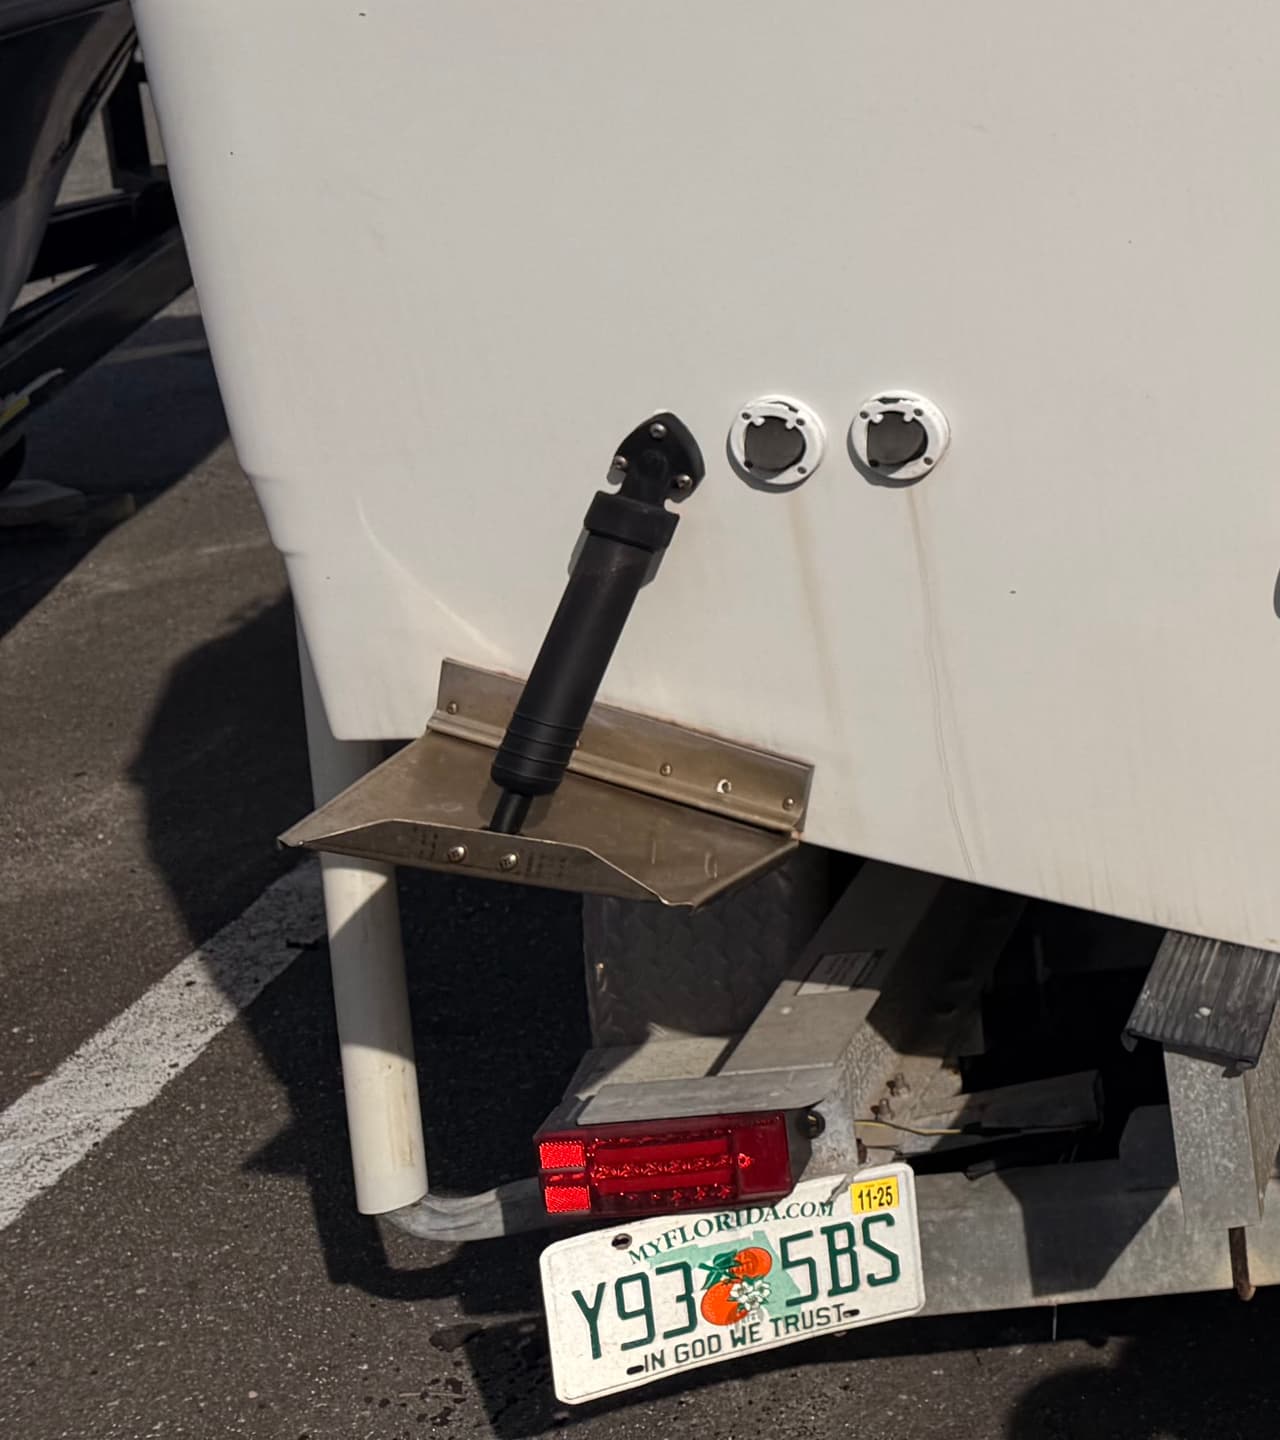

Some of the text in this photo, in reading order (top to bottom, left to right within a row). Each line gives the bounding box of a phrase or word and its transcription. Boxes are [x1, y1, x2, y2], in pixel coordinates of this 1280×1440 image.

[857, 1186, 893, 1211] 11-25
[627, 1201, 835, 1265] MYFLORIDA.COM
[644, 1303, 846, 1374] IN GOD WE TRUST
